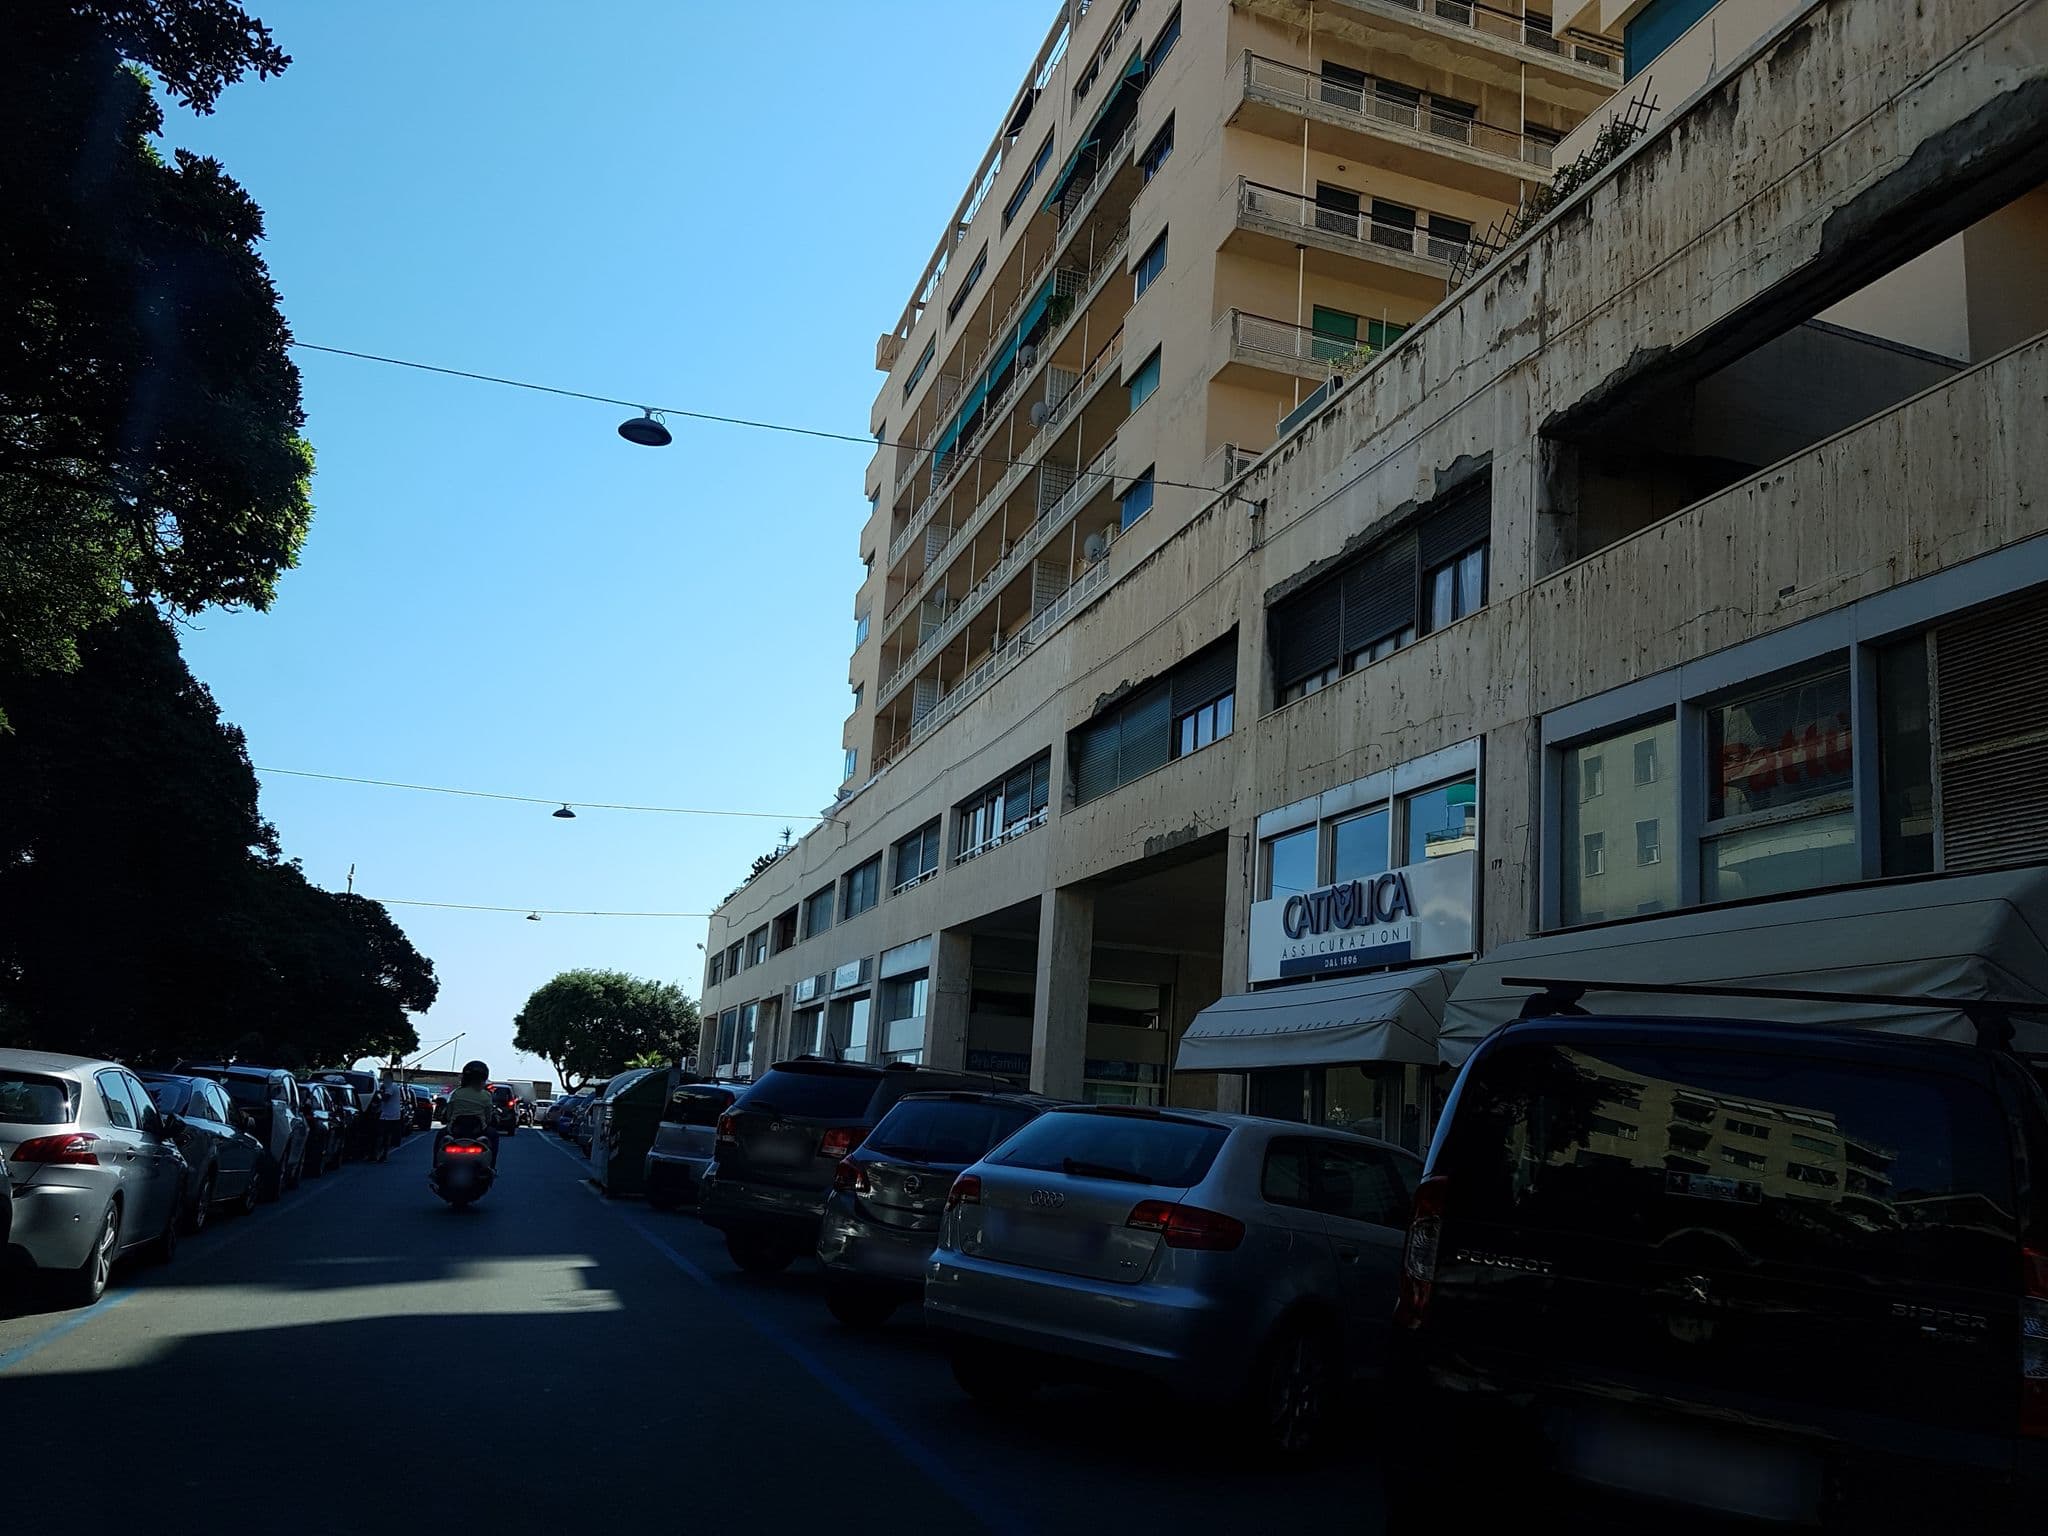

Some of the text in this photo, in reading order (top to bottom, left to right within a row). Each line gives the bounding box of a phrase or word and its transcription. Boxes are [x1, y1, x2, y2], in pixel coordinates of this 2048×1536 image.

[1282, 871, 1413, 939] CATTOLICA
[1281, 926, 1410, 959] ASSICURAZIONI
[1324, 954, 1358, 968] DAL 1896
